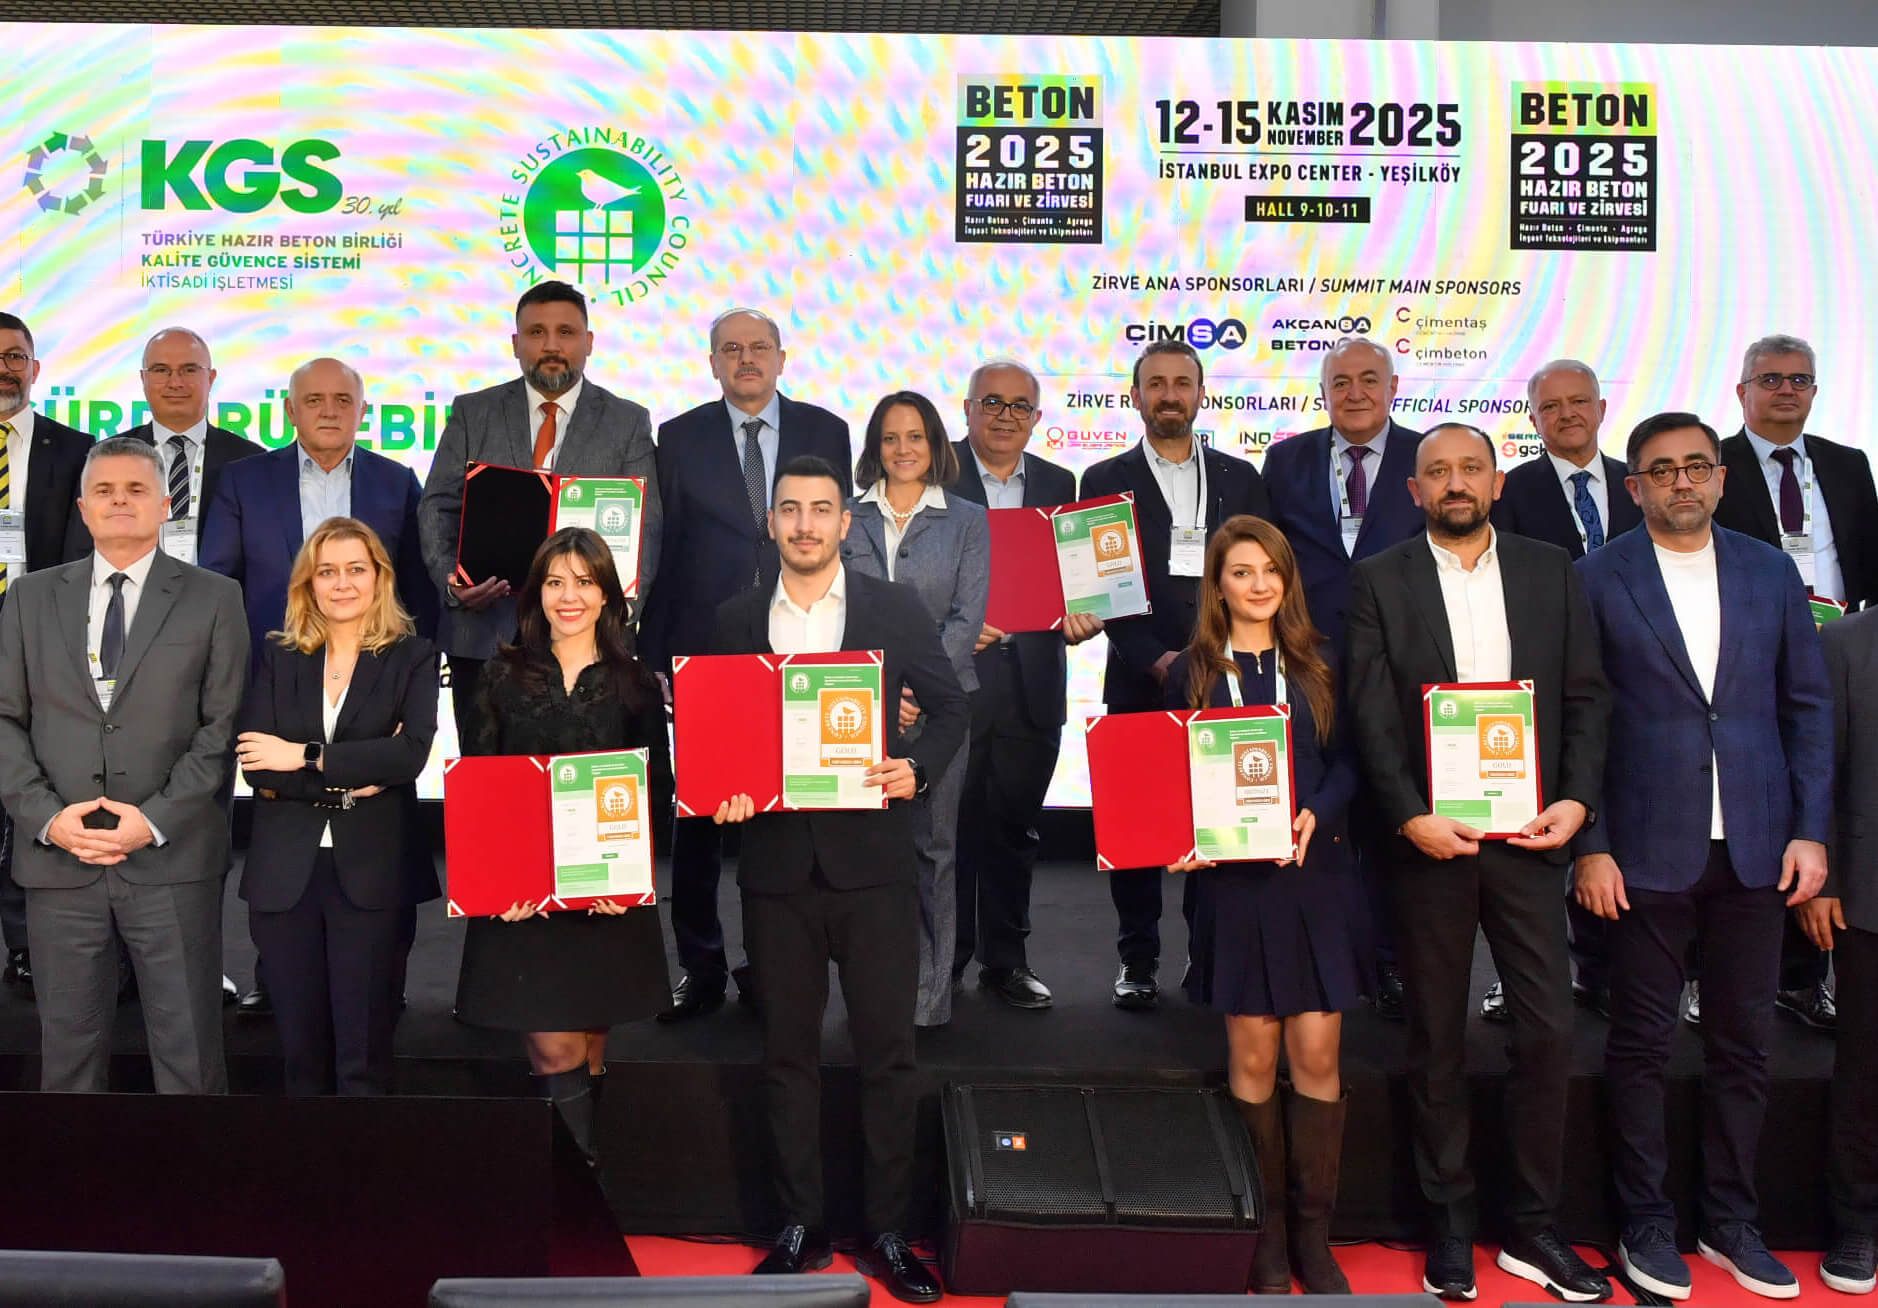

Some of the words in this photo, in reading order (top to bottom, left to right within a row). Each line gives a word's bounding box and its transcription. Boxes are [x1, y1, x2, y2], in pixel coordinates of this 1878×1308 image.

[967, 85, 1094, 119] BETON
[1521, 93, 1647, 127] BETON
[1155, 99, 1261, 144] 12-15
[1267, 101, 1344, 125] KASIM
[1350, 102, 1461, 147] 2025
[1267, 130, 1344, 146] NOVEMBER
[965, 134, 1094, 168] 2025
[1520, 141, 1648, 176] 2025
[512, 127, 688, 202] SUSTAINABILITY
[1160, 159, 1242, 180] İSTANBUL
[1250, 163, 1291, 180] EXPO
[1298, 164, 1361, 181] CENTER
[1380, 162, 1460, 186] YEŞİLKÖY
[142, 139, 343, 214] KGS
[966, 172, 1027, 190] HAZIR
[1032, 173, 1094, 190] BETON
[1520, 180, 1581, 197] HAZIR
[1586, 181, 1647, 198] BETON
[341, 197, 374, 215] 30.
[966, 194, 1009, 208] FUARI
[1014, 194, 1032, 208] VE
[1036, 191, 1093, 208] ZİRVESİ
[1257, 202, 1294, 217] HALL
[1300, 202, 1357, 217] 9-10-11
[1520, 201, 1564, 215] FUARI
[1568, 201, 1586, 215] VE
[1590, 199, 1647, 216] ZİRVESİ
[142, 230, 215, 247] TÜRKİYE
[222, 234, 273, 248] HAZIR
[280, 235, 336, 248] BETON
[343, 231, 402, 249] BİRLİĞİ
[500, 193, 544, 286] NCRETE
[142, 250, 201, 267] KALİTE
[208, 252, 287, 269] GÜVENCE
[293, 252, 361, 270] SİSTEMİ
[611, 216, 690, 306] COUNCIL
[142, 272, 208, 289] İKTİSADİ
[212, 273, 293, 292] İŞLETMESİ
[1093, 274, 1139, 290] ZİRVE
[1145, 277, 1180, 291] ANA
[1185, 277, 1304, 292] SPONSORLARI
[1320, 279, 1385, 293] SUMMIT
[1389, 280, 1430, 294] MAIN
[1435, 280, 1521, 295] SPONSORS
[1416, 316, 1487, 331] çimentaş
[1126, 319, 1246, 349] ÇİMSA
[1416, 347, 1487, 360] çimbeton
[1067, 391, 1114, 408] ZİRVE
[1201, 396, 1296, 411] ONSORLARI
[1392, 398, 1453, 413] FFICIAL
